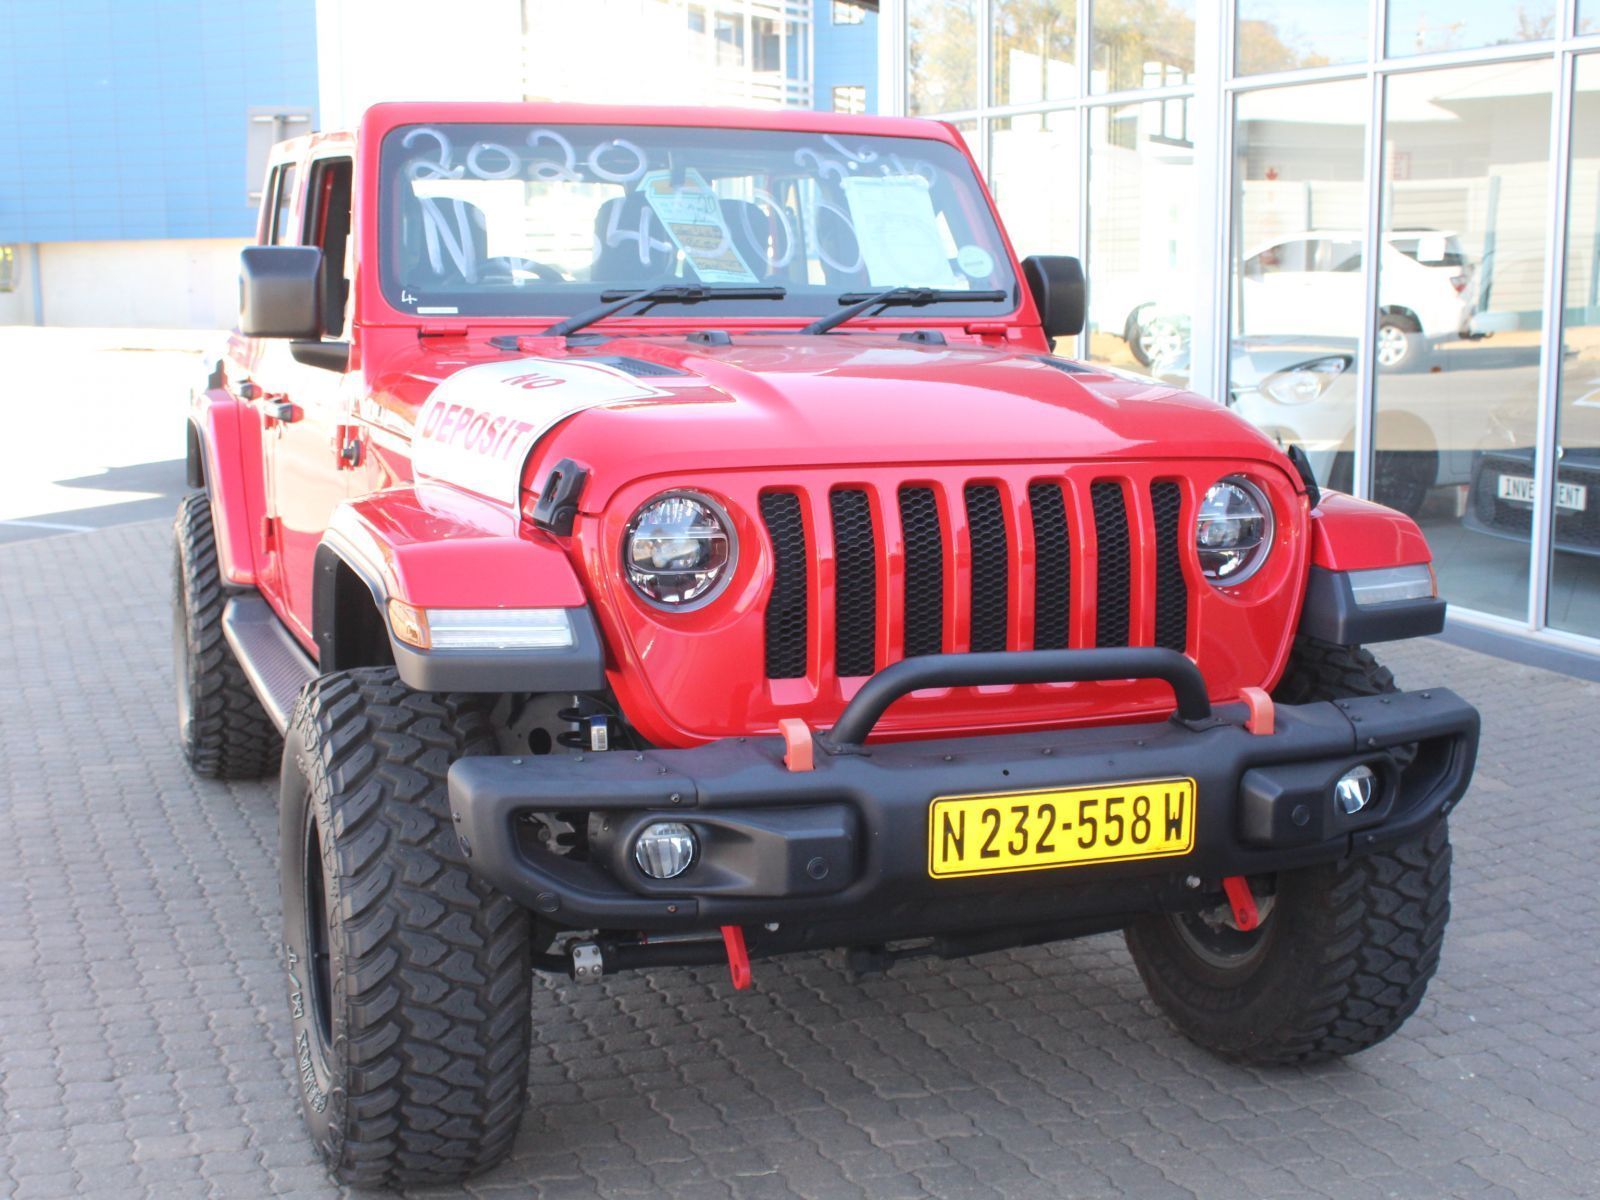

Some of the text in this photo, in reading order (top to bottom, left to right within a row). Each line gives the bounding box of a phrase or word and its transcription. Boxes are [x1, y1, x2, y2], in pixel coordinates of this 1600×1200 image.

[402, 128, 647, 181] 2020
[401, 290, 418, 304] 4
[501, 372, 567, 390] NO
[422, 401, 536, 461] DEPOSIT
[1505, 478, 1581, 505] INVEENT
[942, 791, 1185, 862] N 232-558 W
